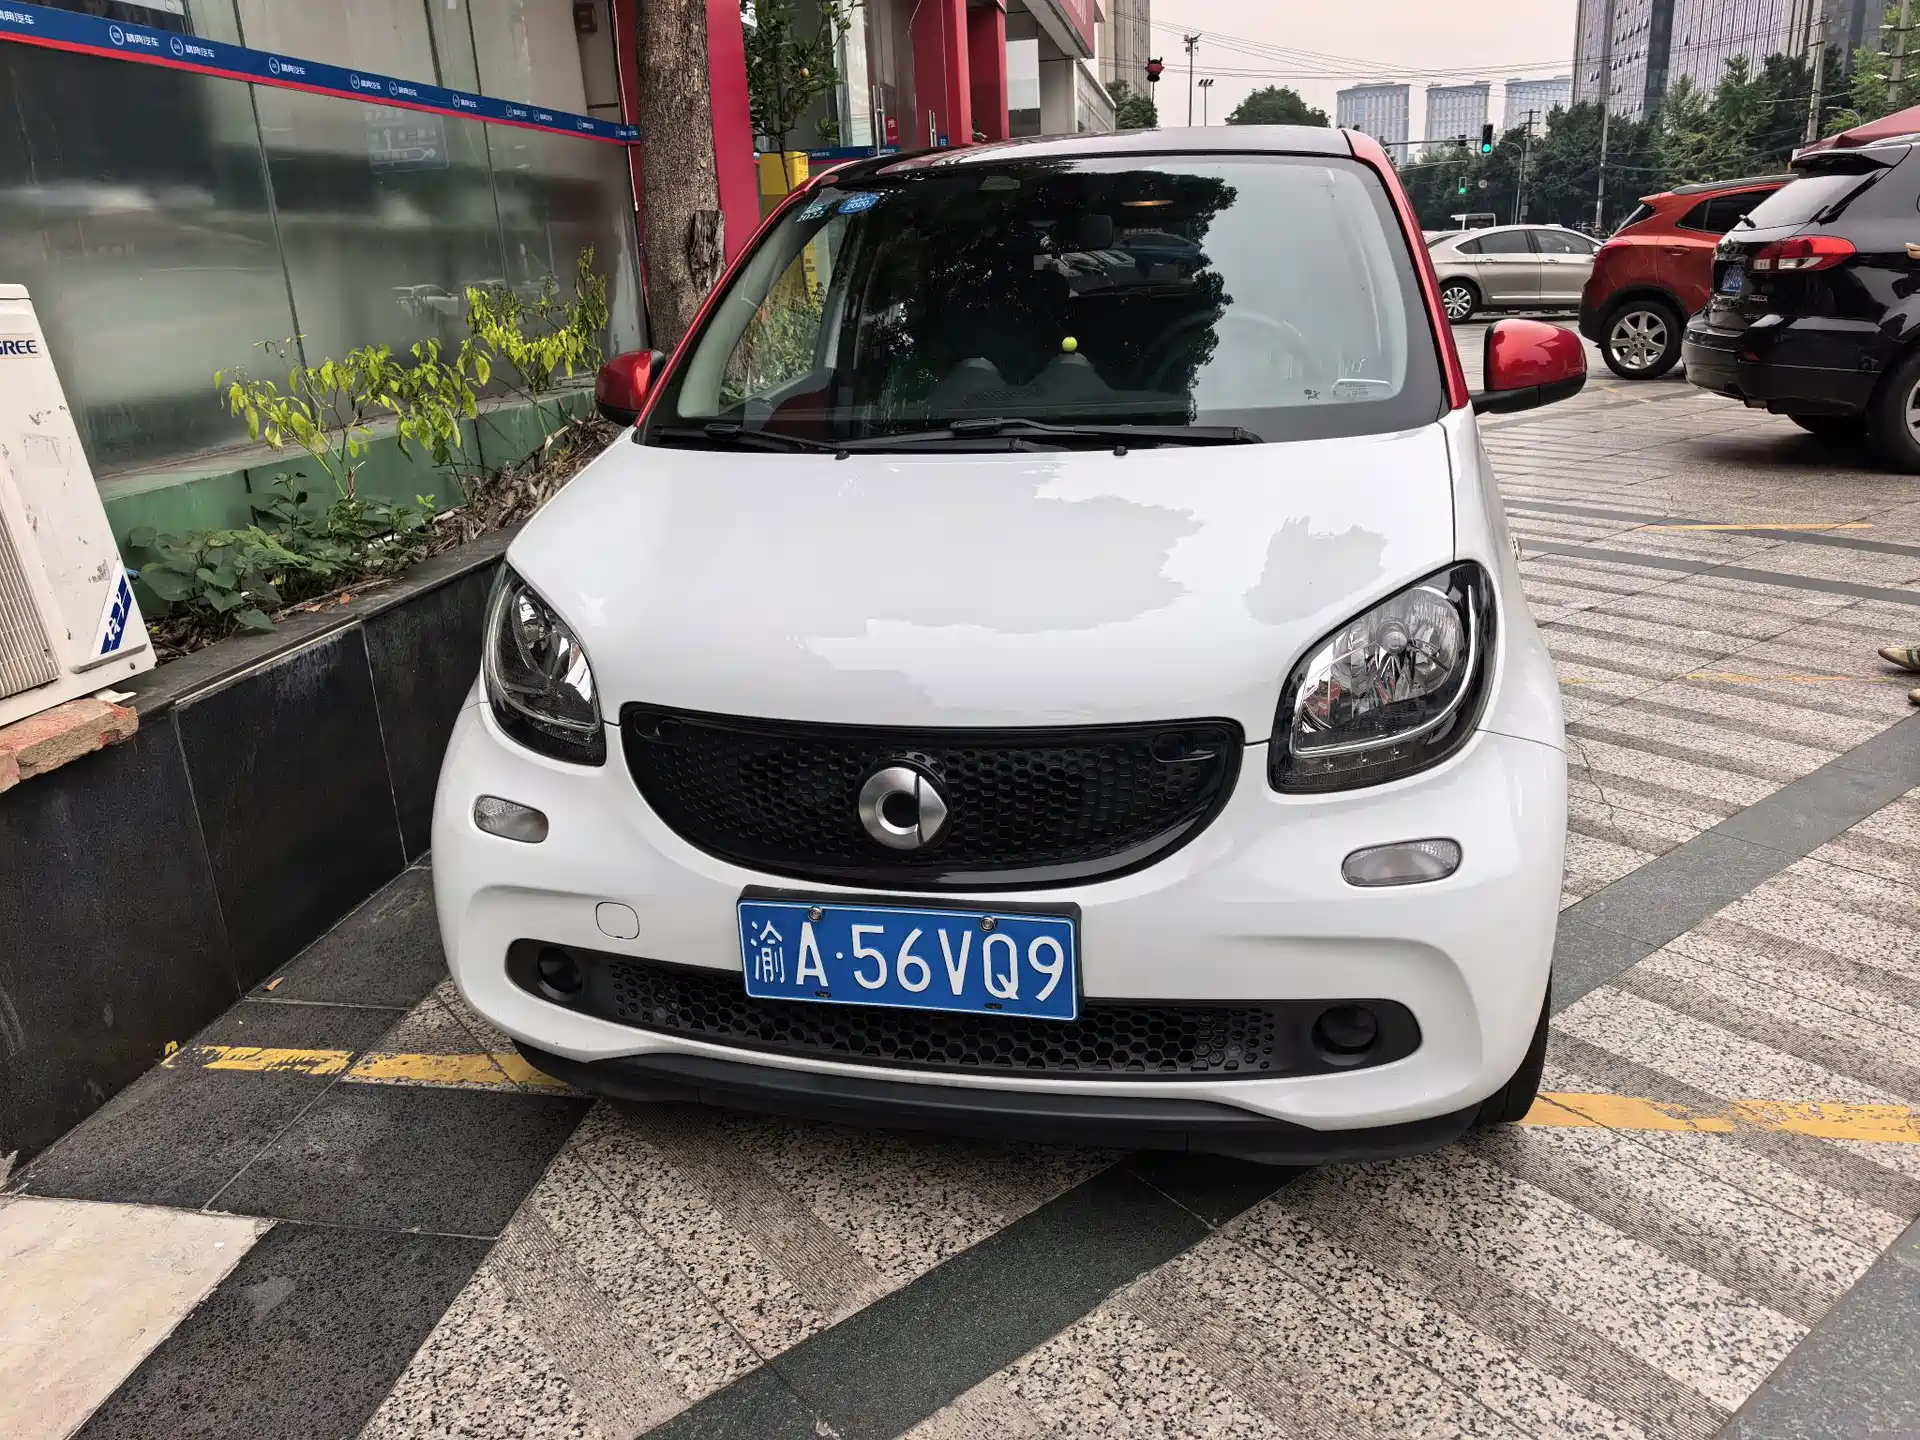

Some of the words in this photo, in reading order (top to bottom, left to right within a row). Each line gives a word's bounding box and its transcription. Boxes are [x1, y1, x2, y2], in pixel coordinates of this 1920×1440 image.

[125, 32, 160, 47] 精典汽车
[0, 340, 38, 355] REE
